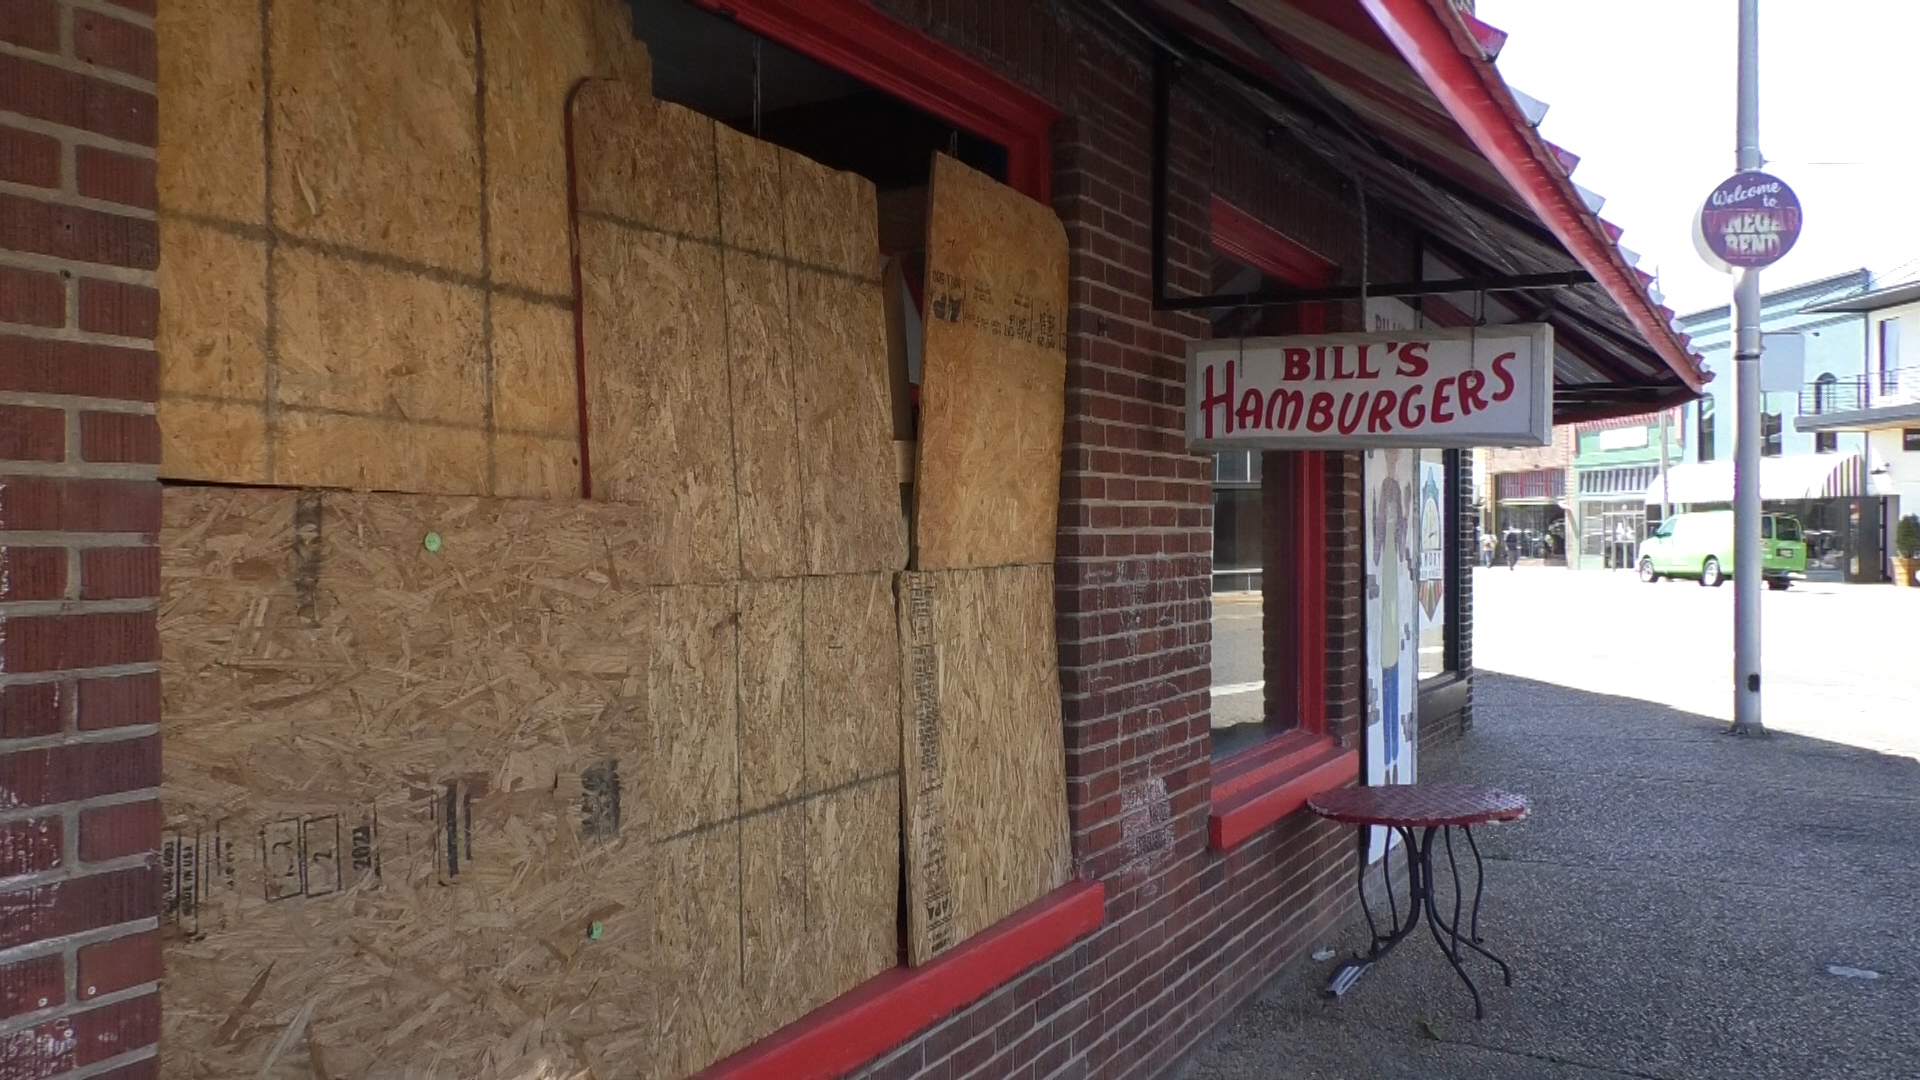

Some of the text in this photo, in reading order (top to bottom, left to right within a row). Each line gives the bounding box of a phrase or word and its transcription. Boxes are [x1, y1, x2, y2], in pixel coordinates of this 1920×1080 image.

[1712, 181, 1781, 206] Welcome
[1763, 194, 1778, 207] to
[1724, 233, 1780, 259] BEND
[1282, 341, 1430, 381] BILL'S
[1200, 351, 1517, 440] HAMBURGERS
